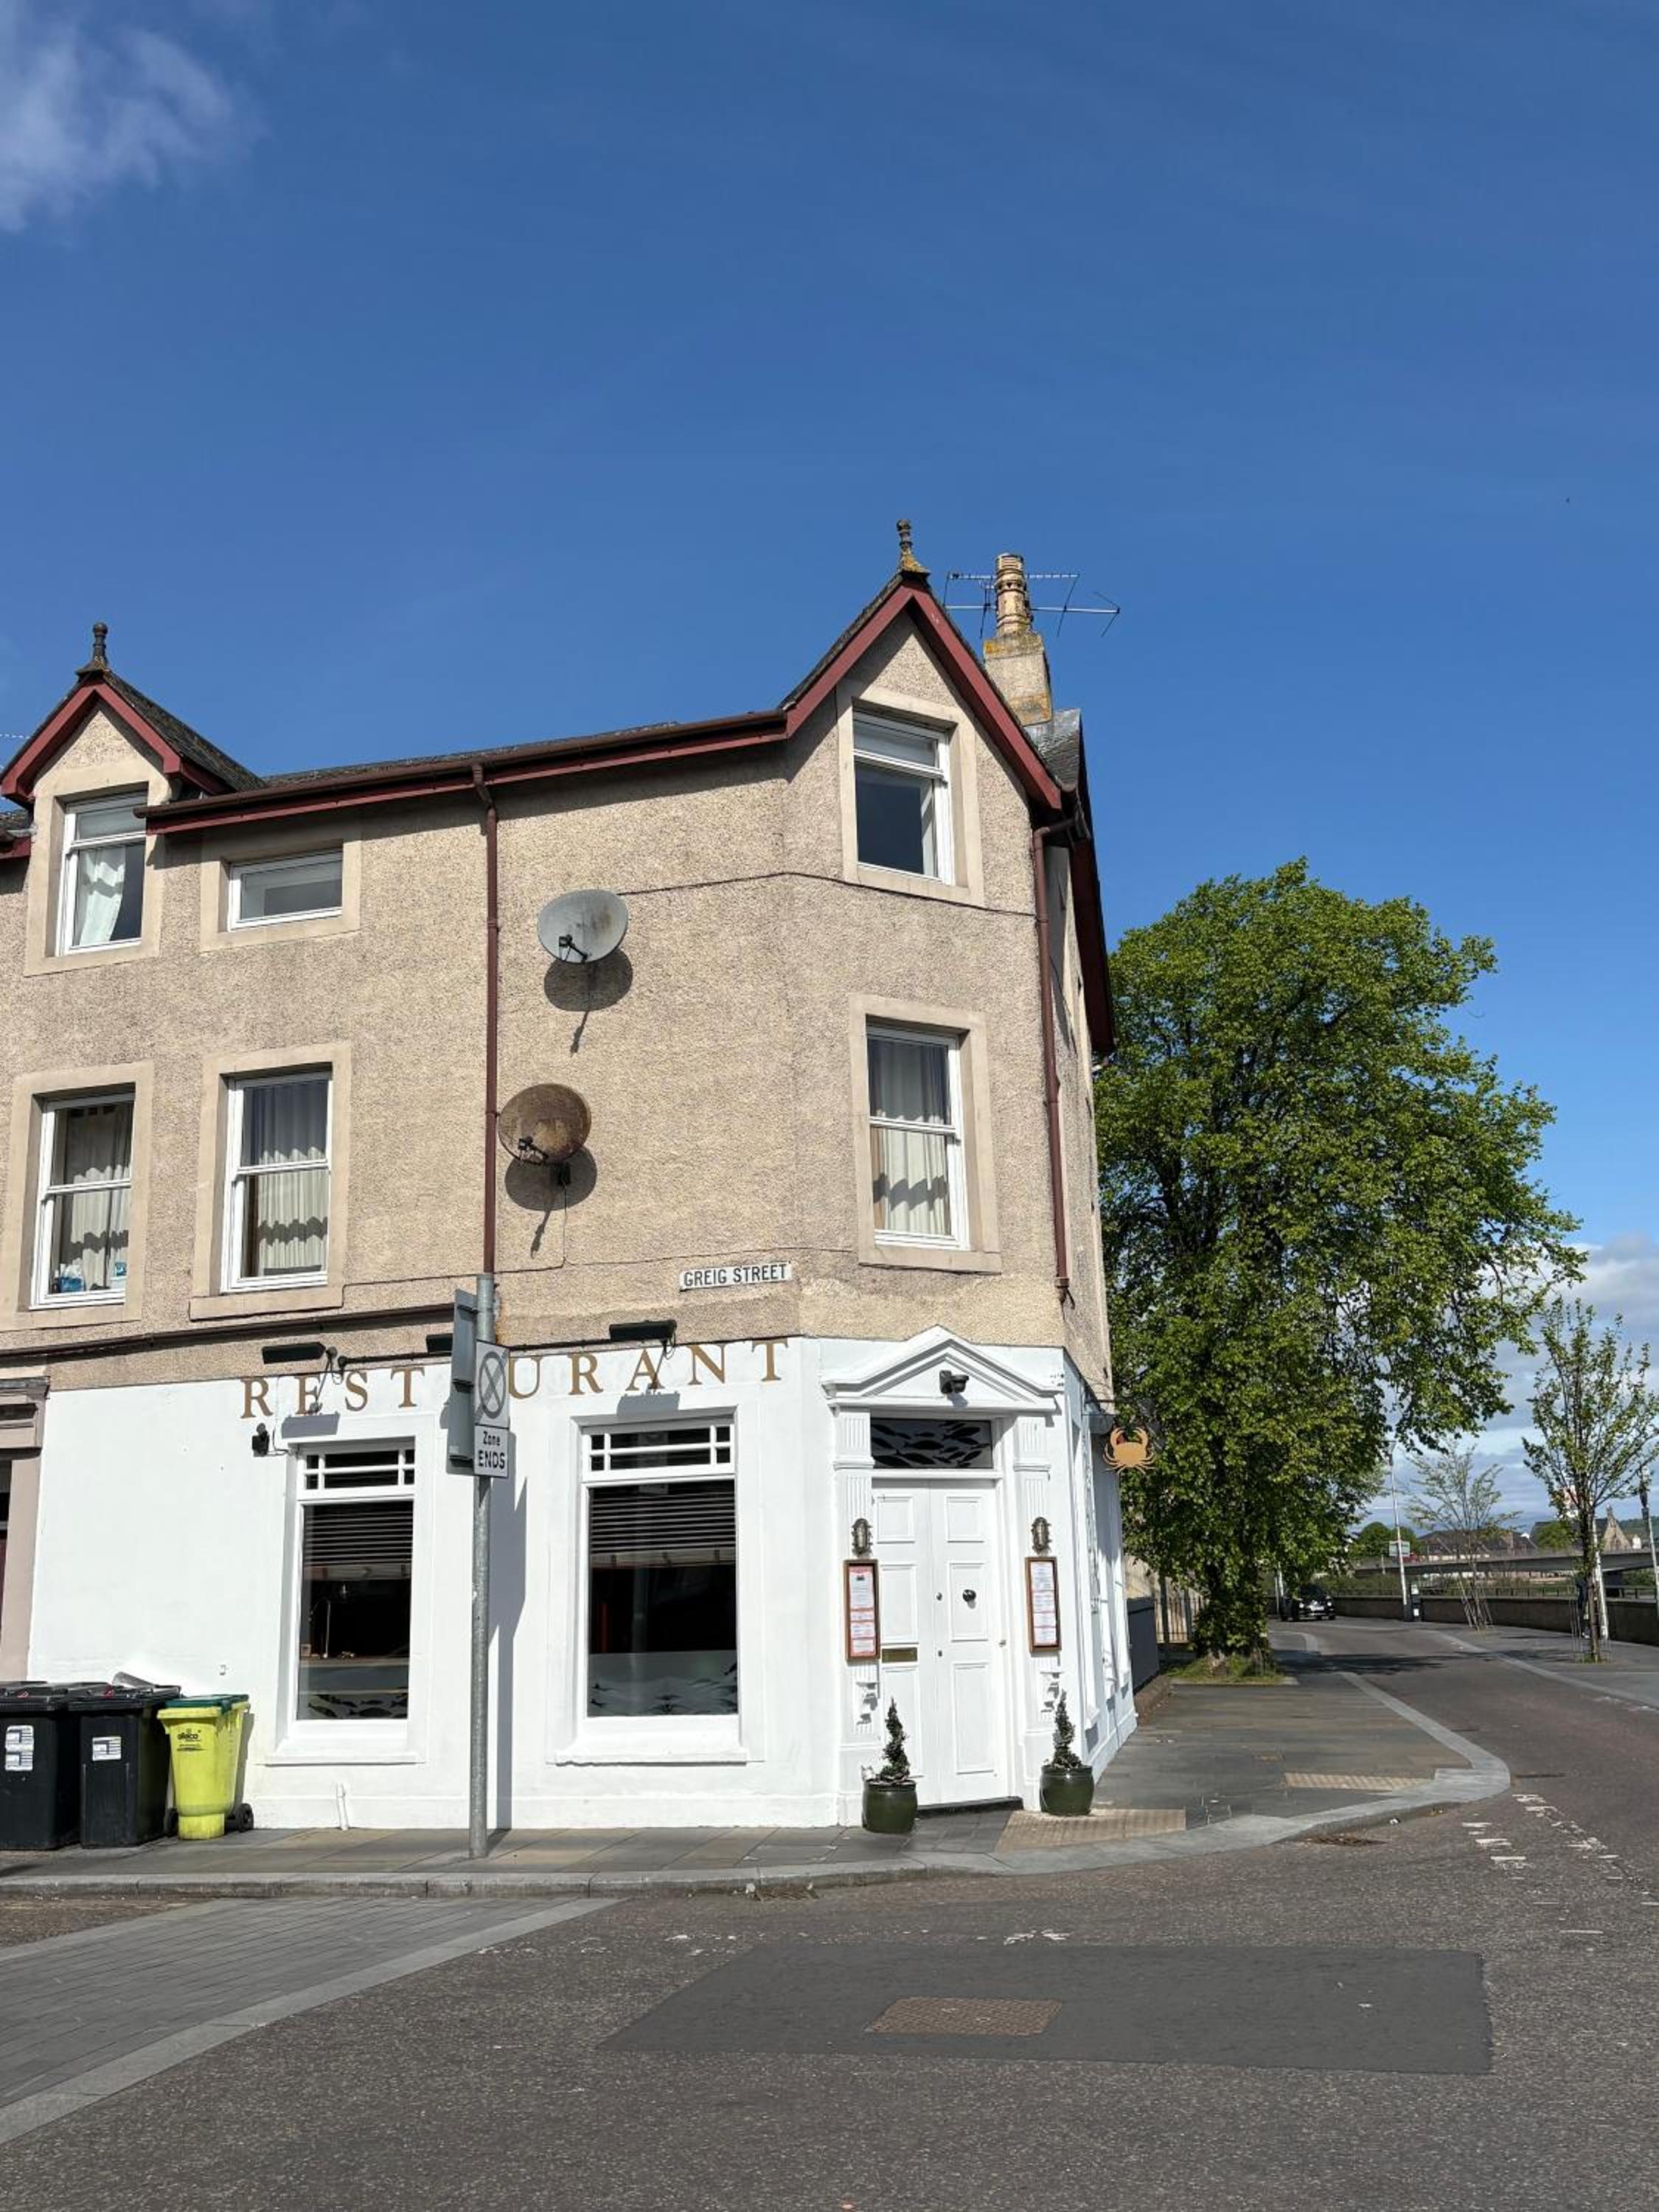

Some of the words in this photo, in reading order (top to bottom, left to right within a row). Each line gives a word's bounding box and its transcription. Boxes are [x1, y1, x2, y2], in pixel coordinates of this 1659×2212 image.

[684, 1269, 726, 1287] GREIG
[733, 1264, 787, 1283] STREET
[240, 1338, 788, 1419] RESTURANT
[483, 1430, 501, 1446] Zone
[479, 1450, 505, 1470] ENDS
